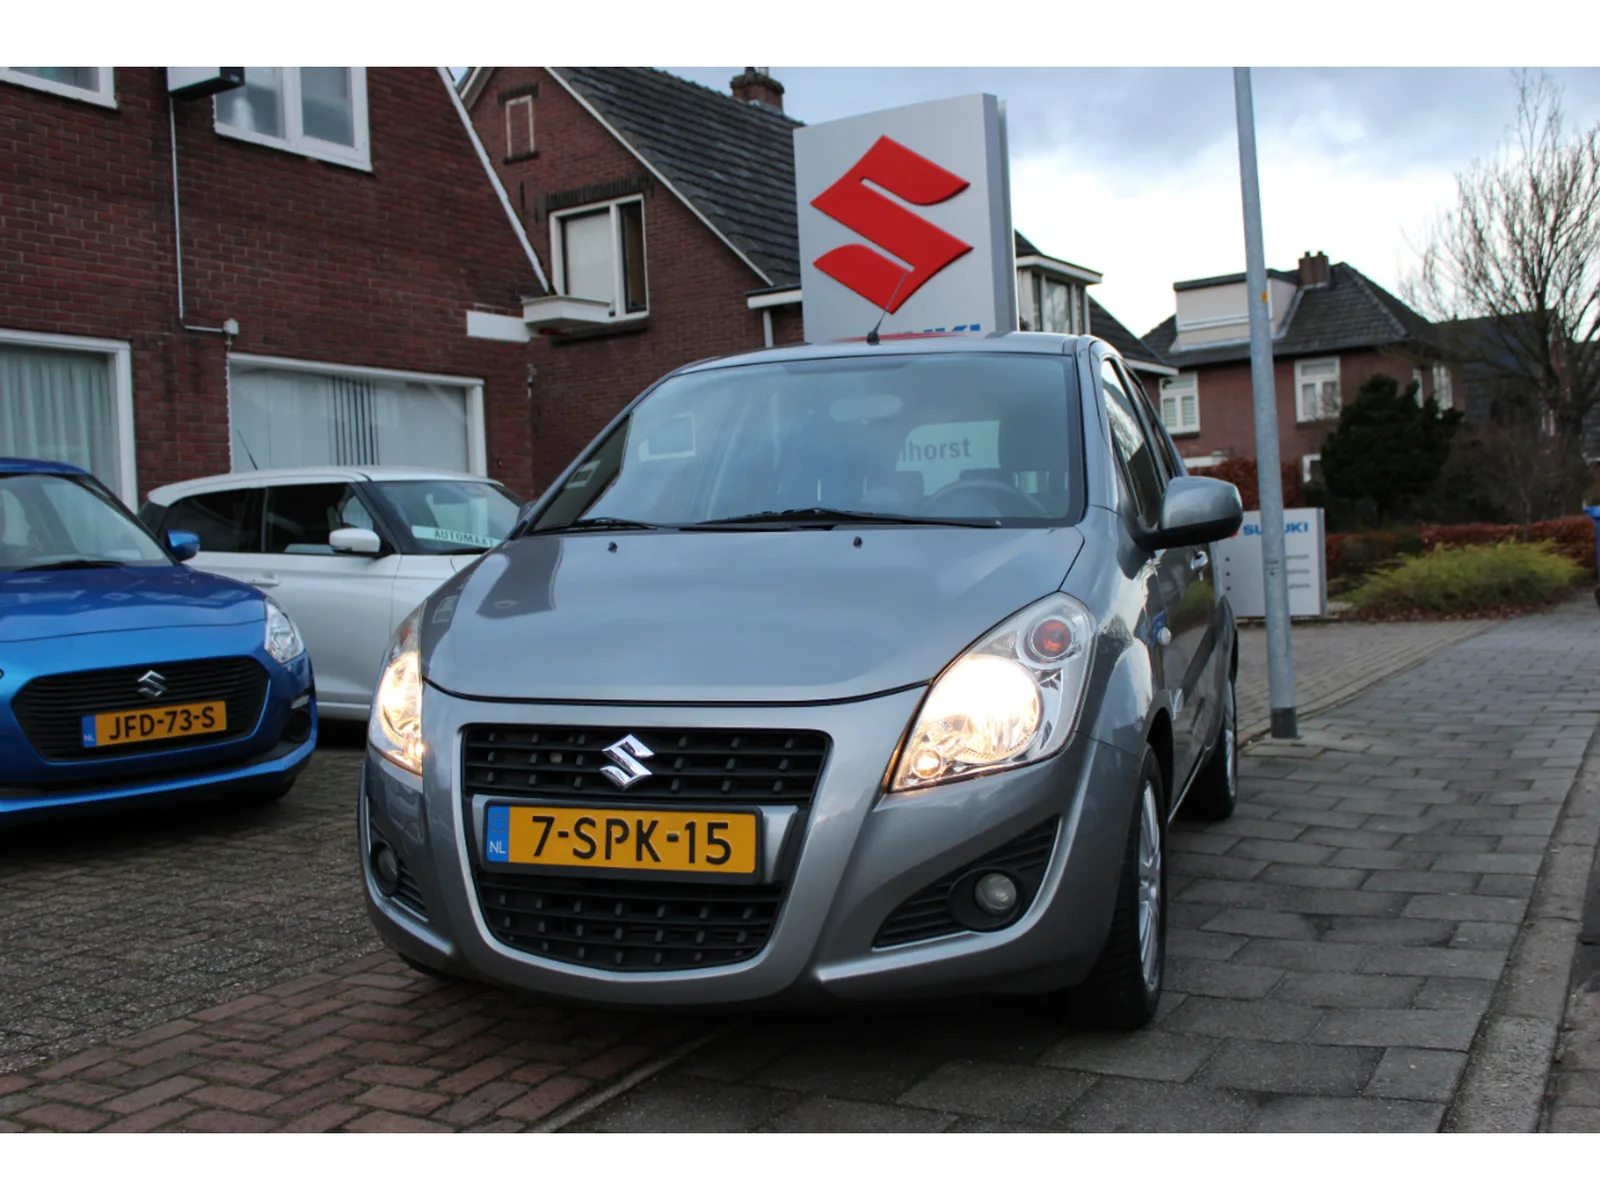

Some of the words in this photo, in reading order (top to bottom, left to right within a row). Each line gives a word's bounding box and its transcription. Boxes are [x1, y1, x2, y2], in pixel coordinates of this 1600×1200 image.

[434, 529, 495, 548] AUTOMAAT
[1243, 522, 1309, 536] SUUKI
[109, 706, 215, 741] JFD-73-S
[489, 840, 506, 855] NL
[532, 815, 732, 866] 7-SPK-15
